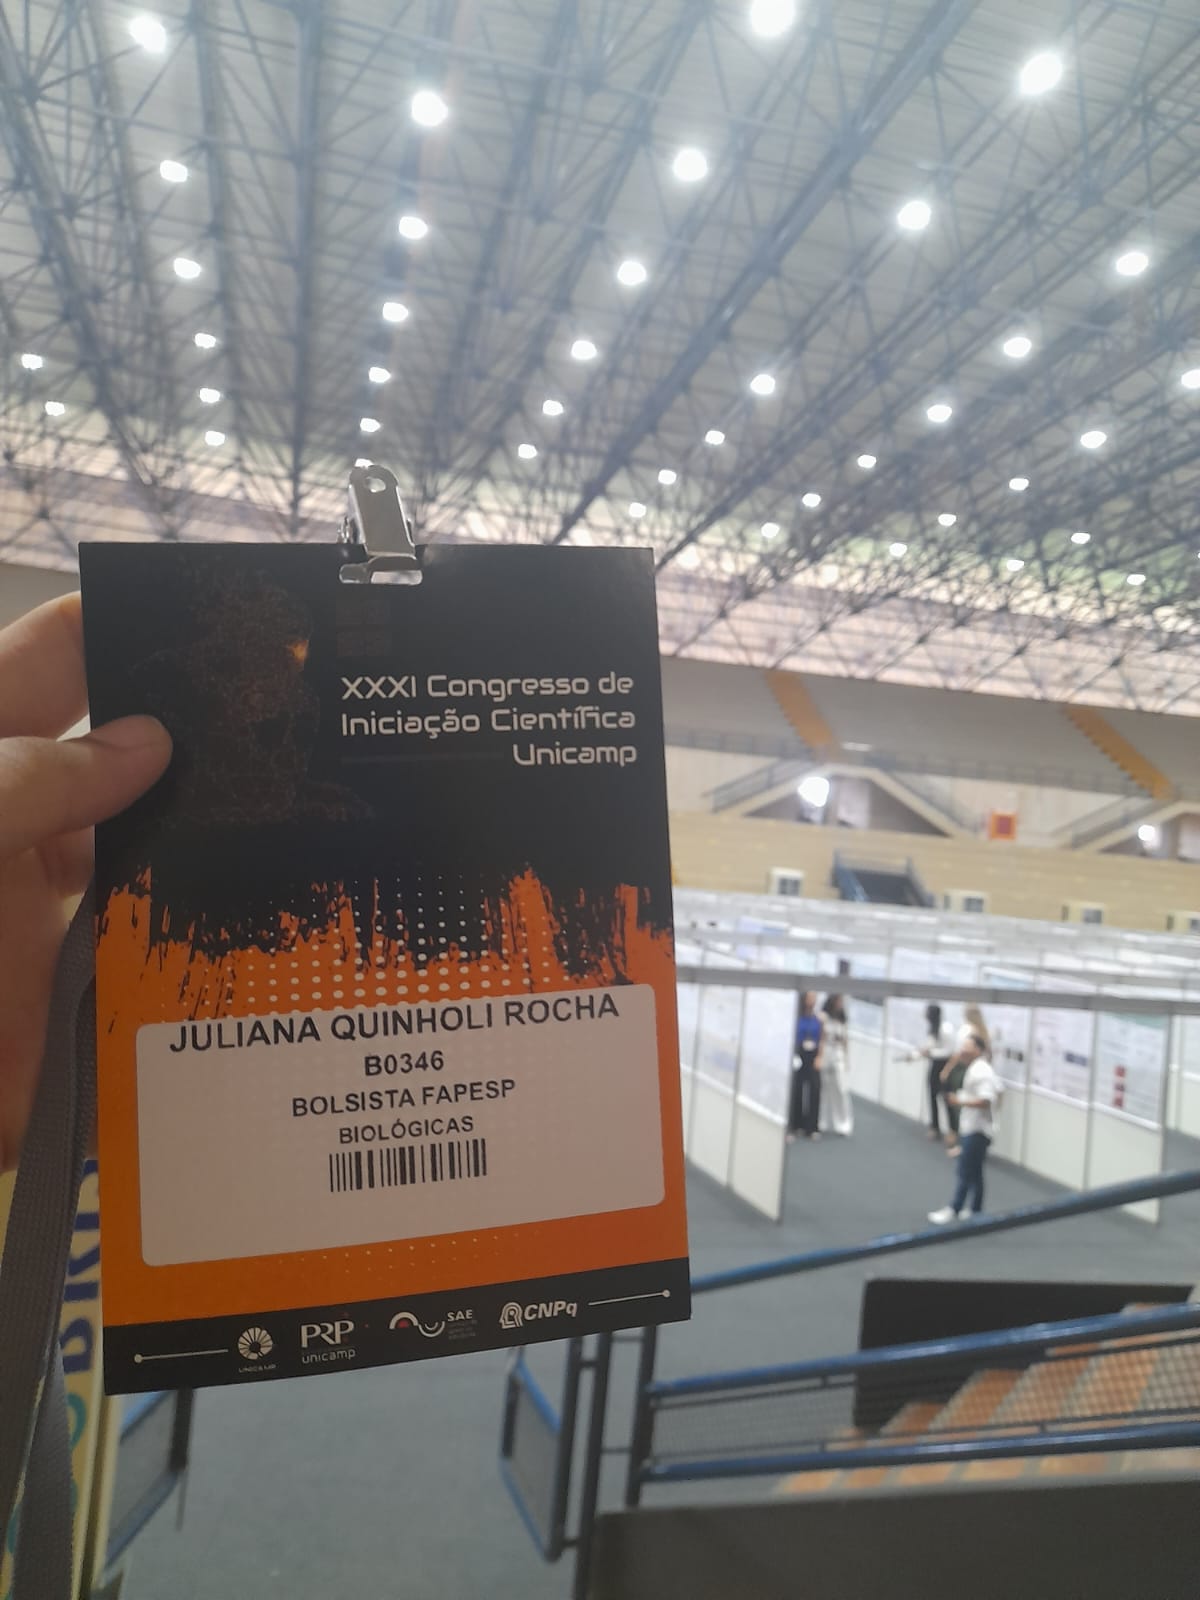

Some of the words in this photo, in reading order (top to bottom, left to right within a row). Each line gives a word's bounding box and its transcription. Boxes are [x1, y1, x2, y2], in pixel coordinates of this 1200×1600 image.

[341, 676, 417, 699] XXXI
[427, 674, 590, 702] Congresso
[598, 671, 634, 694] de
[341, 708, 481, 739] Iniciação
[491, 706, 635, 731] Científica
[512, 741, 637, 767] Unicamp
[169, 1014, 321, 1053] JULIANA
[330, 1003, 494, 1041] QUINHOLI
[504, 993, 620, 1026] ROCHA
[363, 1050, 445, 1076] B0346
[292, 1087, 416, 1117] BOLSISTA
[422, 1079, 517, 1106] FAPESP
[338, 1115, 475, 1144] BIOLÓGICAS
[446, 1309, 474, 1323] SAE
[523, 1301, 578, 1321] CNPq
[300, 1319, 355, 1349] PRP
[301, 1348, 356, 1364] unicamp
